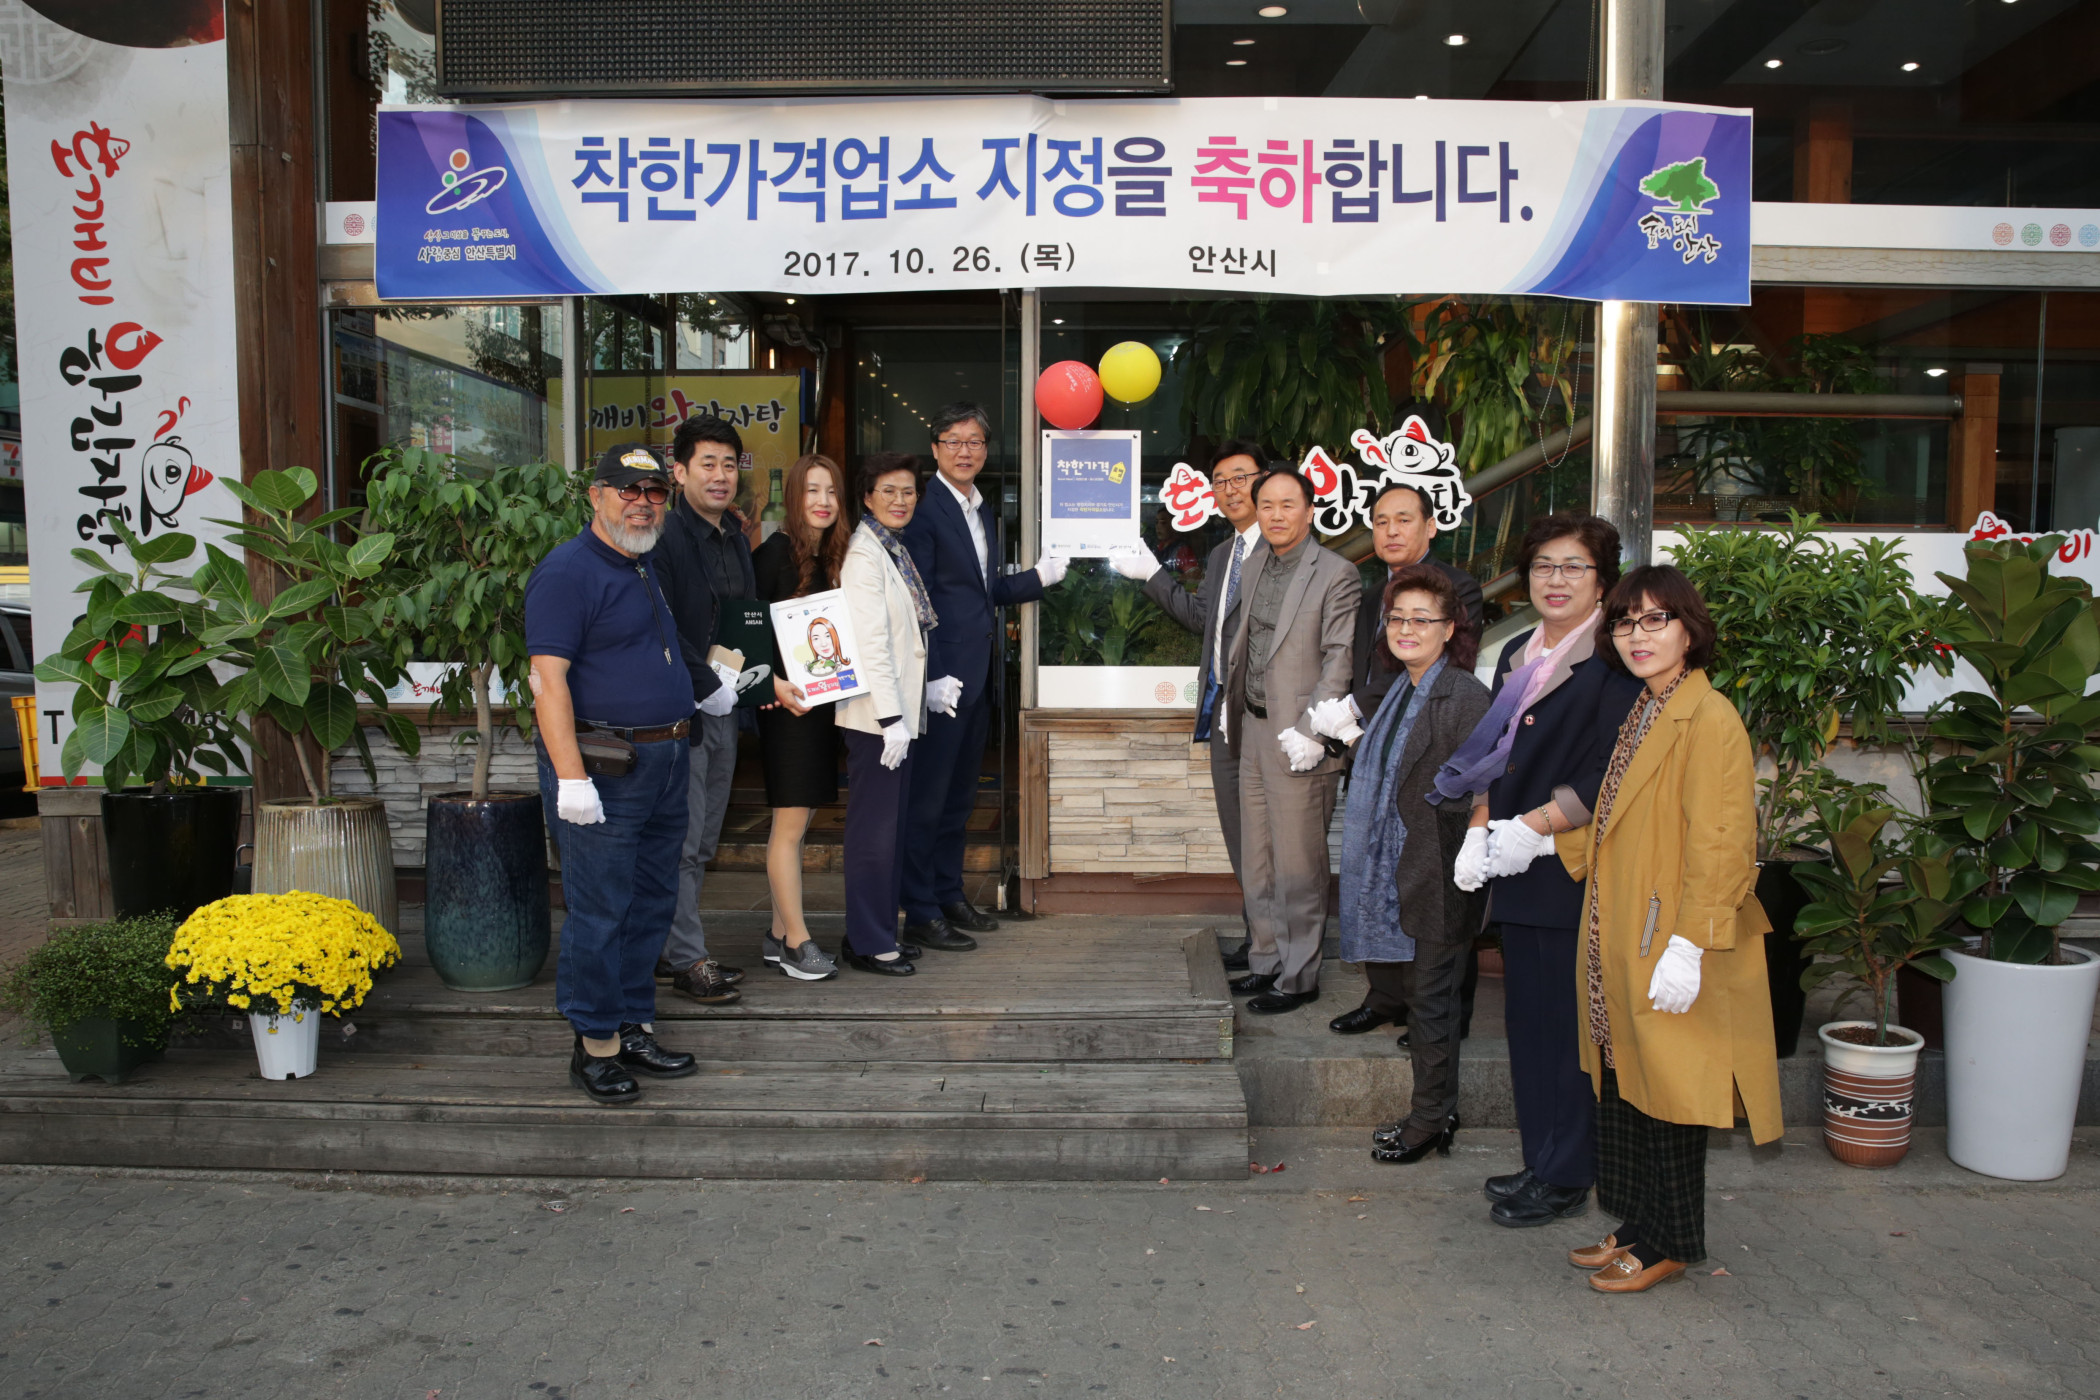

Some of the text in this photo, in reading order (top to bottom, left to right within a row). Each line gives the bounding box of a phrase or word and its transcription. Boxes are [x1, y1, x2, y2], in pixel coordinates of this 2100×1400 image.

[571, 133, 1533, 223] 착한가격업소 지정을 축하합니다.
[1672, 214, 1698, 235] 도시
[418, 244, 516, 263] 사람중심 안산특별시
[783, 242, 1076, 277] 2017. 10. 26. (목)
[1188, 245, 1276, 277] 안산시
[1674, 231, 1721, 264] 안산
[1057, 459, 1109, 476] 착한가격
